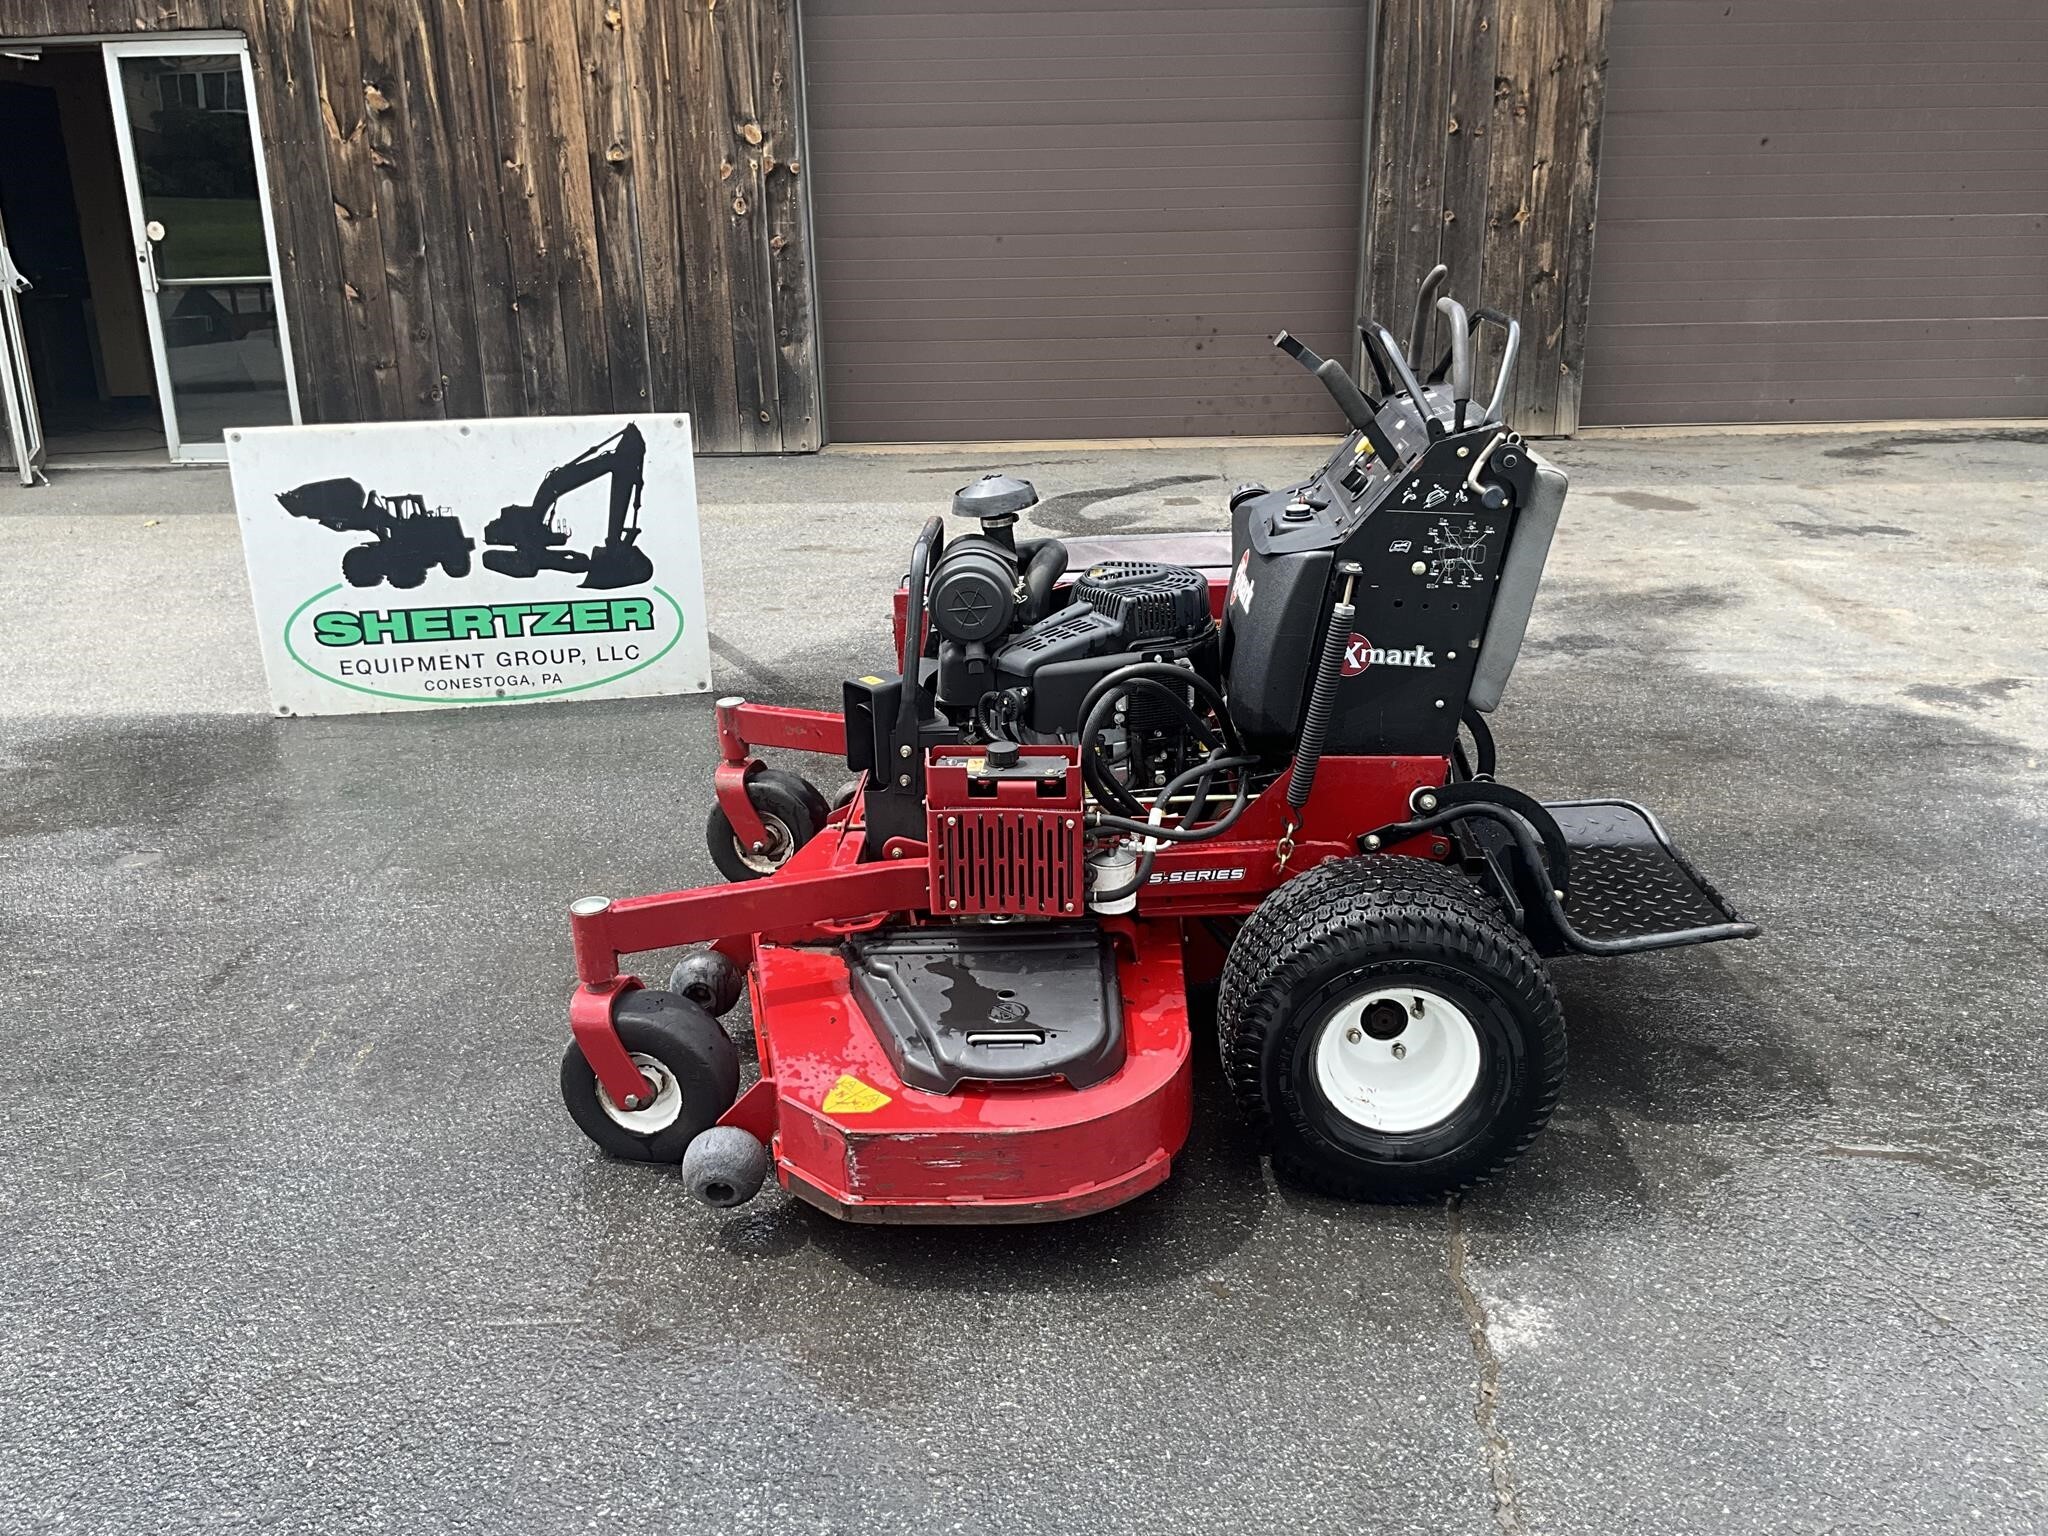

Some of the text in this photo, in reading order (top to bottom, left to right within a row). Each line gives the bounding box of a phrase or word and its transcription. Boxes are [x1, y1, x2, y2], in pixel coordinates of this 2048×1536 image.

[313, 597, 655, 647] SHERTZER
[340, 645, 640, 675] EQUIPMENT GROUP, LLC
[1344, 641, 1435, 668] Xmark
[424, 673, 562, 691] CONESTOGA, PA
[1149, 868, 1244, 883] S-SERIES
